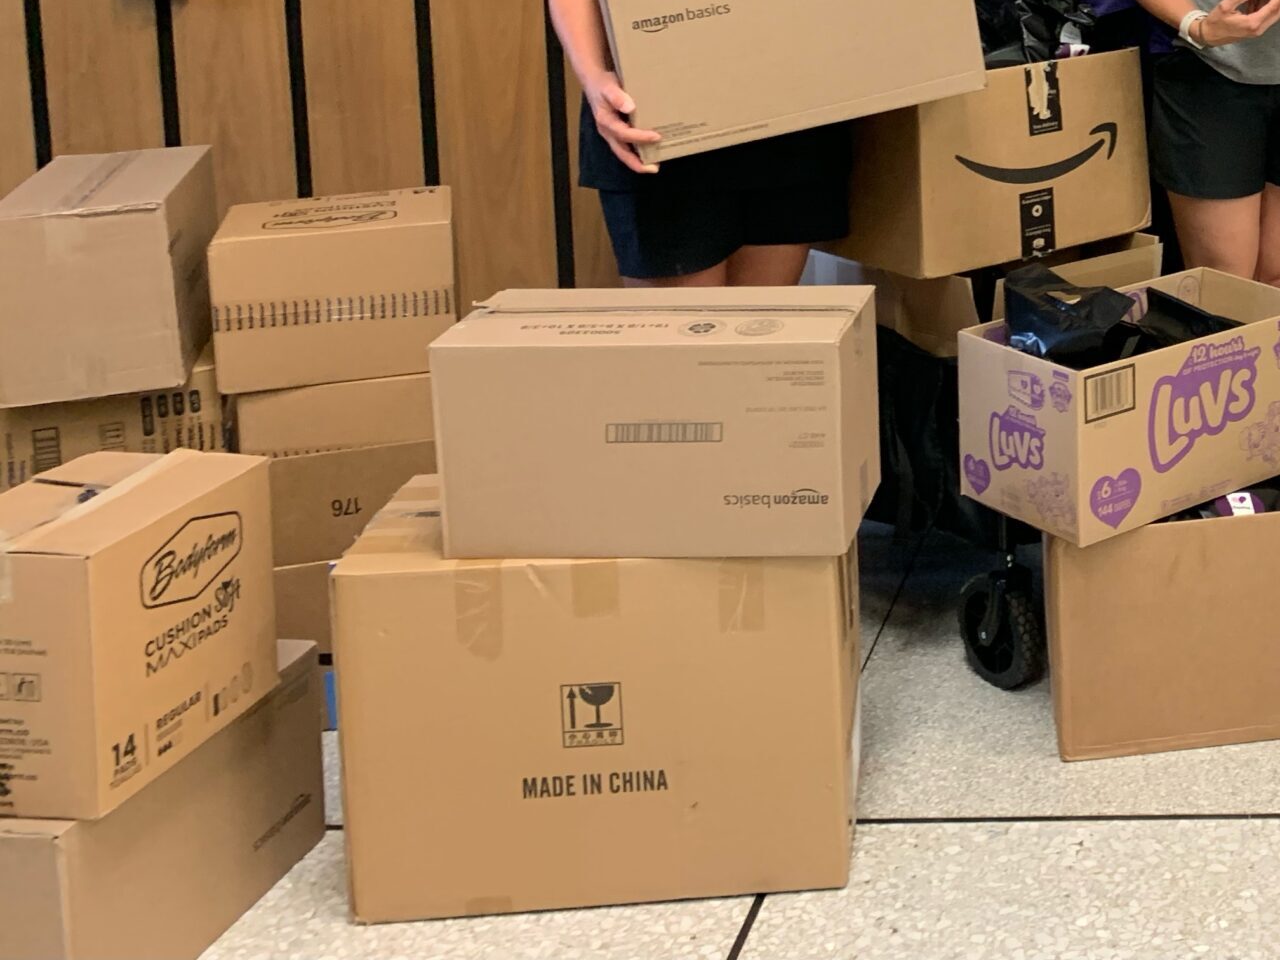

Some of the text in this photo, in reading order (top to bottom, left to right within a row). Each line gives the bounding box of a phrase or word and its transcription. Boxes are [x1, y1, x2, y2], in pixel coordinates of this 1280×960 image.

[632, 3, 731, 30] amazon basics
[1209, 336, 1244, 359] hours
[723, 494, 829, 509] amazon basics
[1101, 480, 1112, 498] 6
[331, 498, 362, 517] 176
[145, 604, 212, 657] CUSHION
[156, 690, 201, 729] REGULAR
[112, 733, 137, 767] 14
[522, 769, 668, 800] MADE IN CHINA
